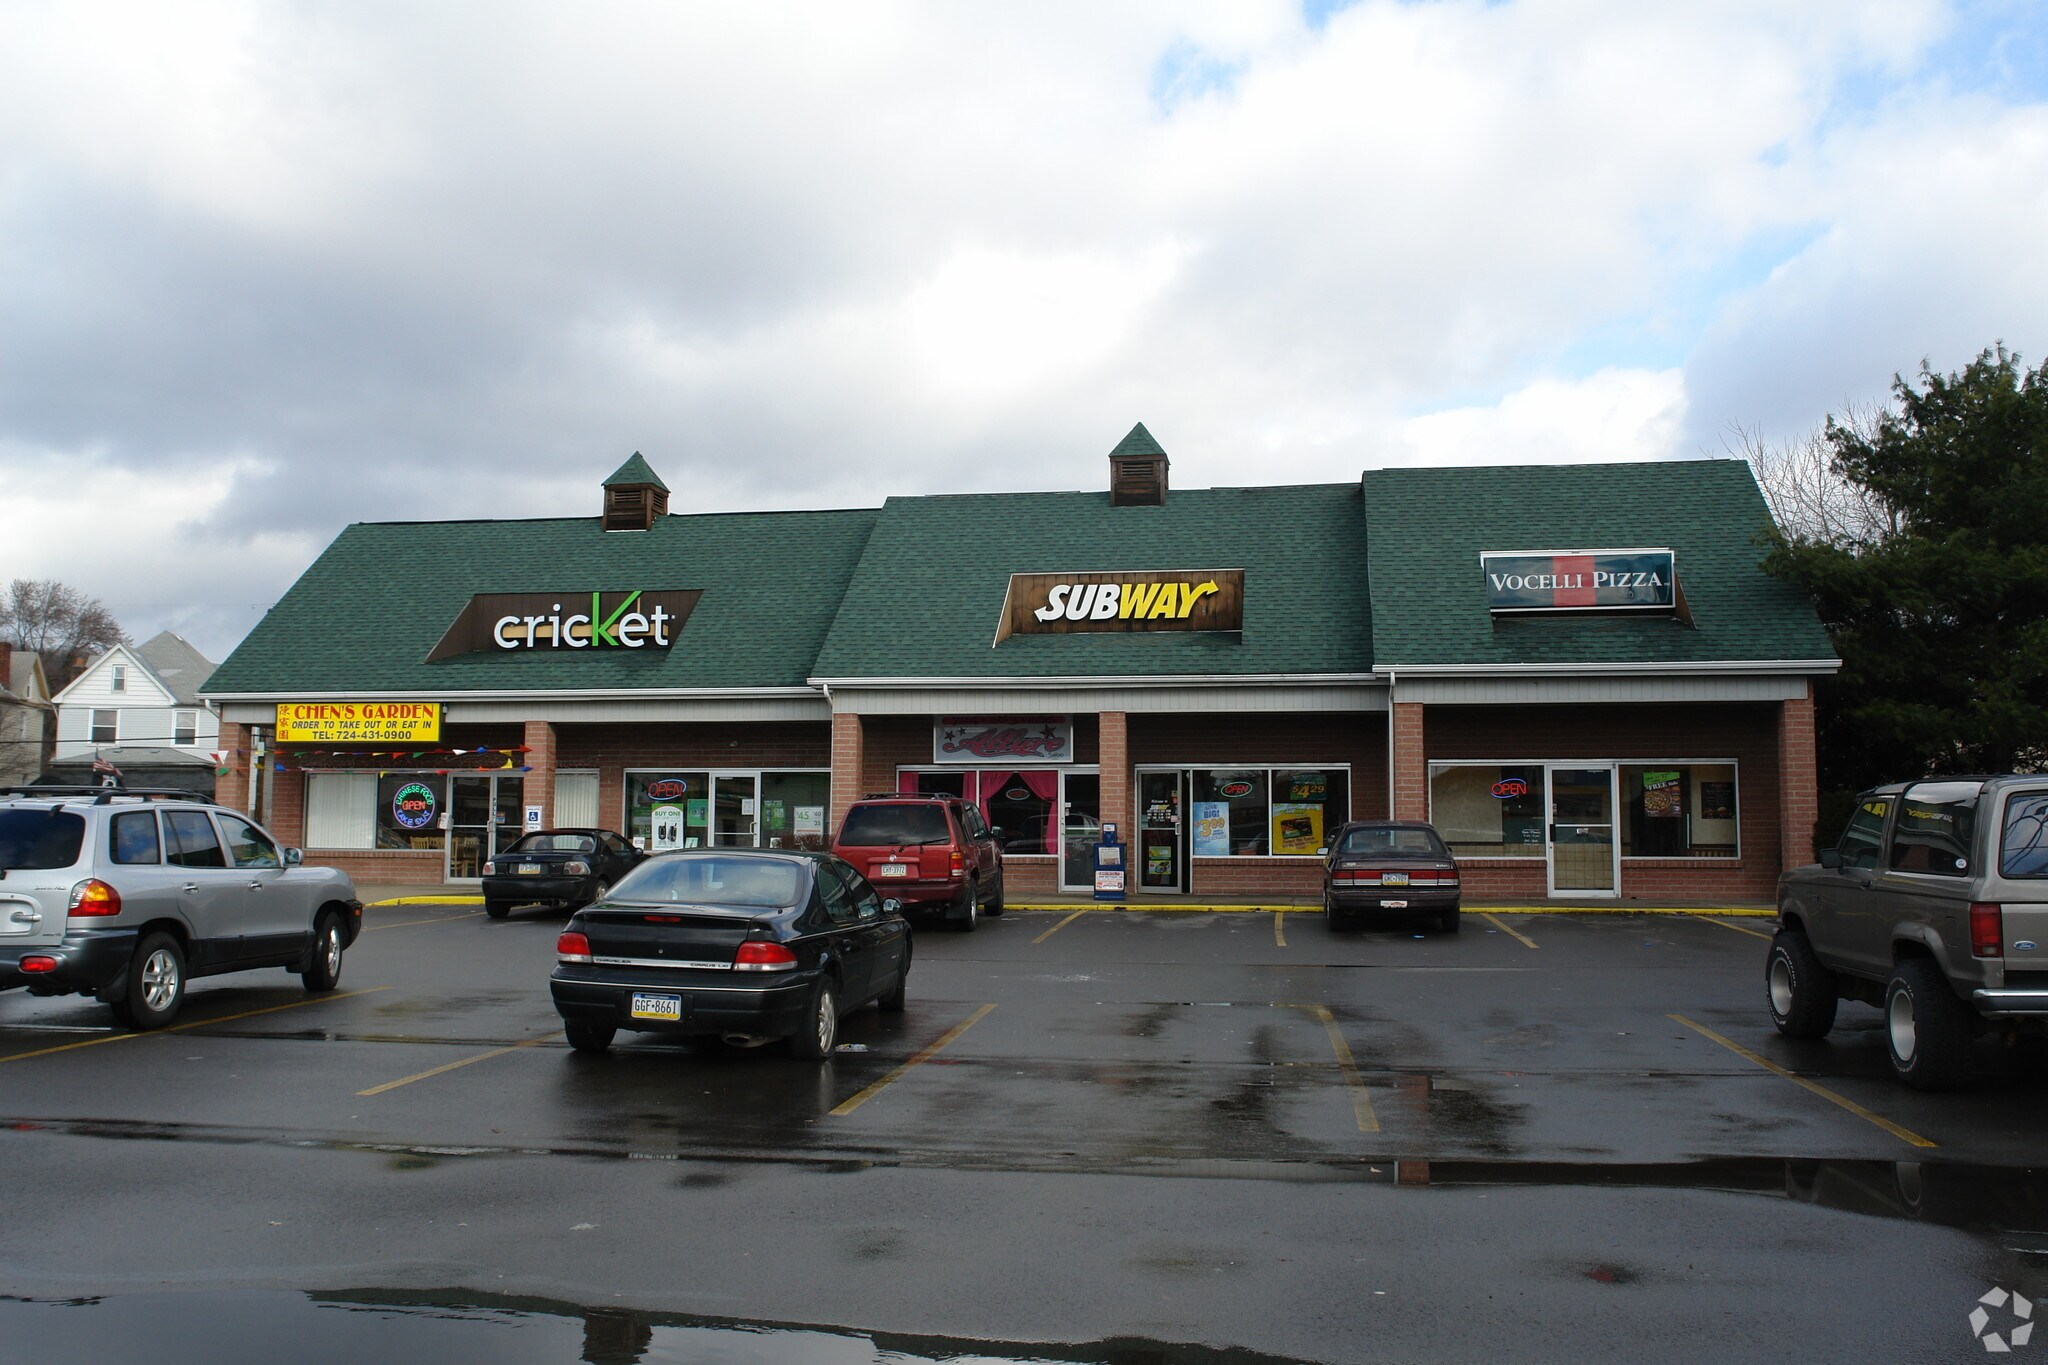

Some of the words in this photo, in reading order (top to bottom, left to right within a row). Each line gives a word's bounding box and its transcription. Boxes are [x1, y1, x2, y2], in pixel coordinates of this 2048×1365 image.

[1490, 573, 1583, 591] VOCELLI
[1592, 571, 1662, 588] PIZZA
[1034, 579, 1219, 623] SUBWAY
[294, 704, 356, 719] CHEN'S
[362, 704, 434, 719] GARDEN
[291, 720, 319, 729] ORDER
[324, 720, 335, 729] TO
[339, 720, 361, 729] TAKE
[364, 720, 382, 728] OUT
[386, 720, 398, 728] OR
[402, 720, 418, 728] EAT
[422, 720, 432, 728] IN
[312, 731, 334, 740] TEL:
[336, 730, 412, 740] 724-431-0900
[420, 787, 433, 805] FOOD
[648, 782, 684, 797] OPEN
[1224, 785, 1250, 794] OPEN
[1491, 783, 1527, 795] OPEN
[402, 800, 426, 810] OPEN
[396, 808, 414, 825] TAKE
[414, 810, 431, 825] OUT
